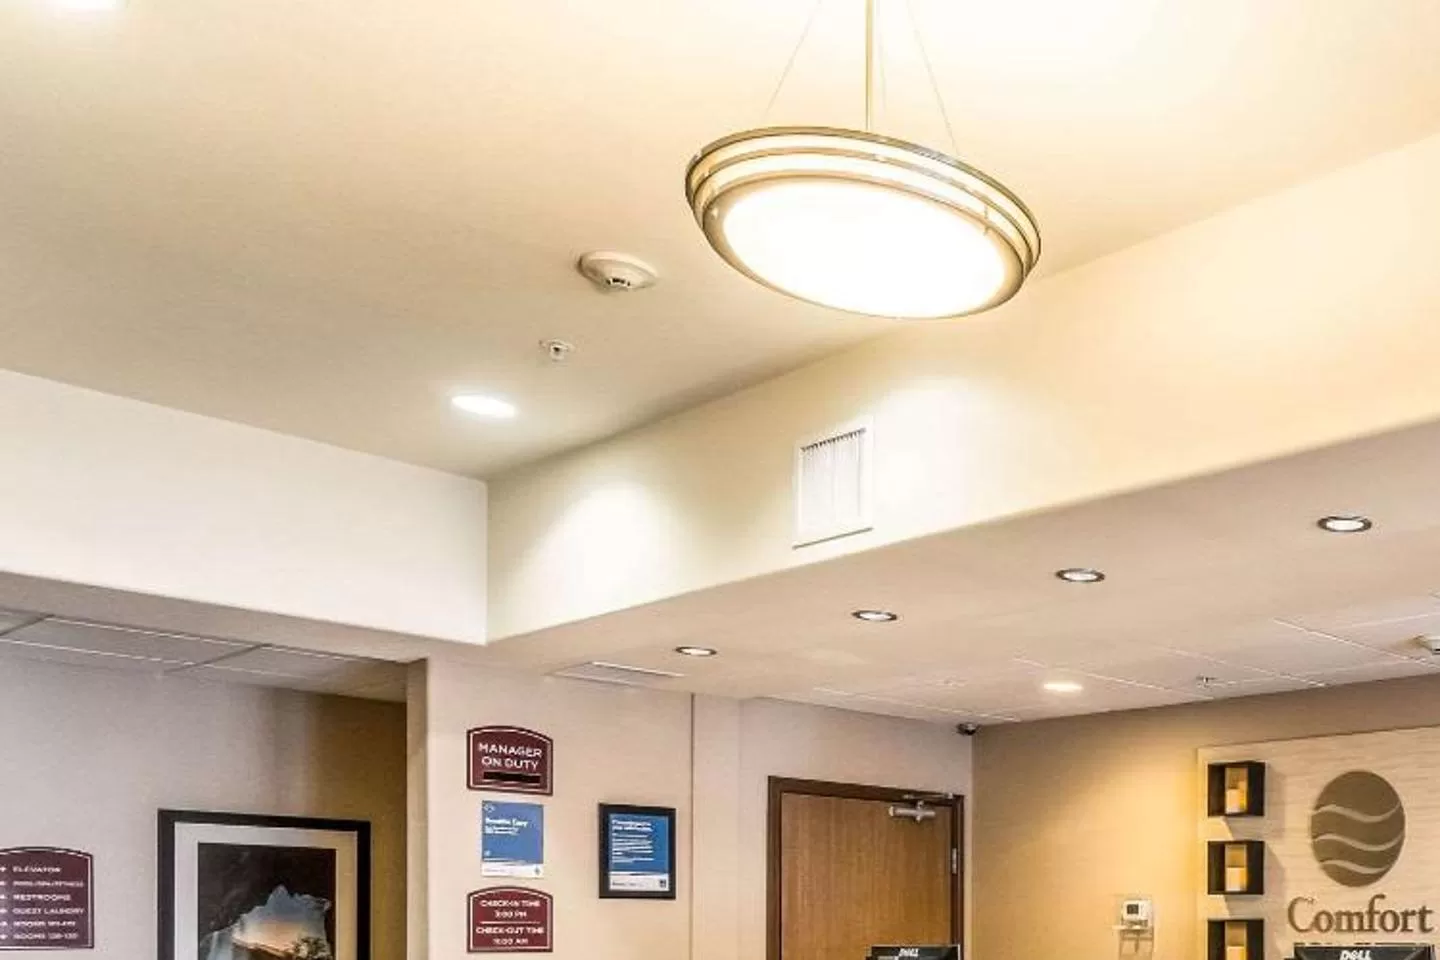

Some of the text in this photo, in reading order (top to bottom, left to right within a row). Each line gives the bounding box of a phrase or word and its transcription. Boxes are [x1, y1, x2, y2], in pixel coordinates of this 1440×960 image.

[478, 742, 542, 758] MANAGER
[481, 756, 539, 771] ON DUTY
[1287, 894, 1435, 934] Comfort
